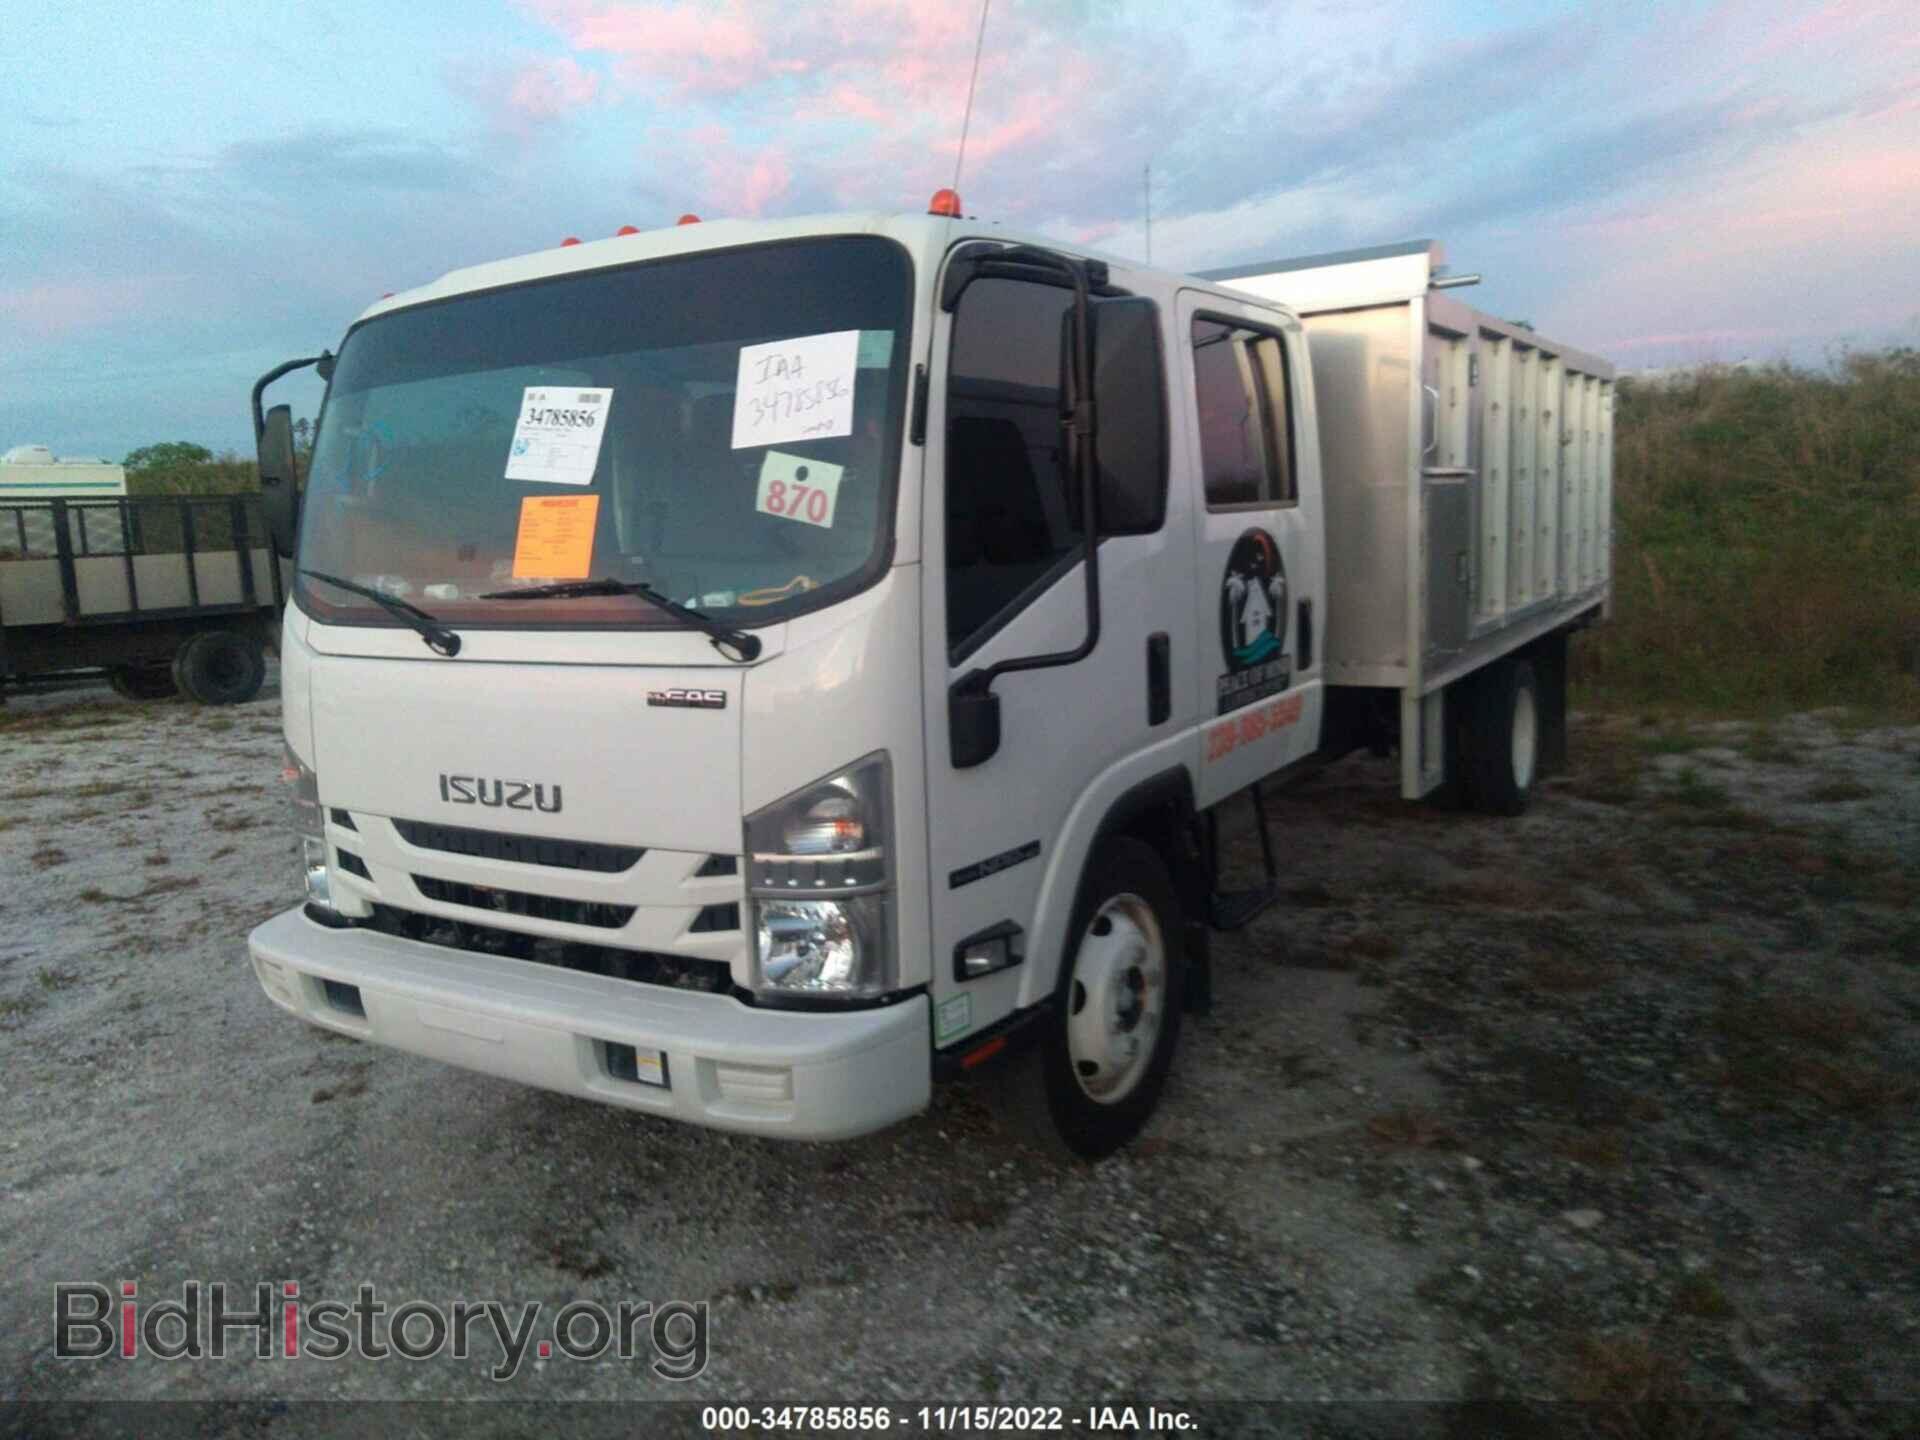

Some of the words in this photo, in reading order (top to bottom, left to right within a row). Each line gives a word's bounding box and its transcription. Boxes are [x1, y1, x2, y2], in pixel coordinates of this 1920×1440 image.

[525, 406, 596, 428] 34785856
[765, 479, 829, 524] 870
[439, 773, 563, 813] ISUZU
